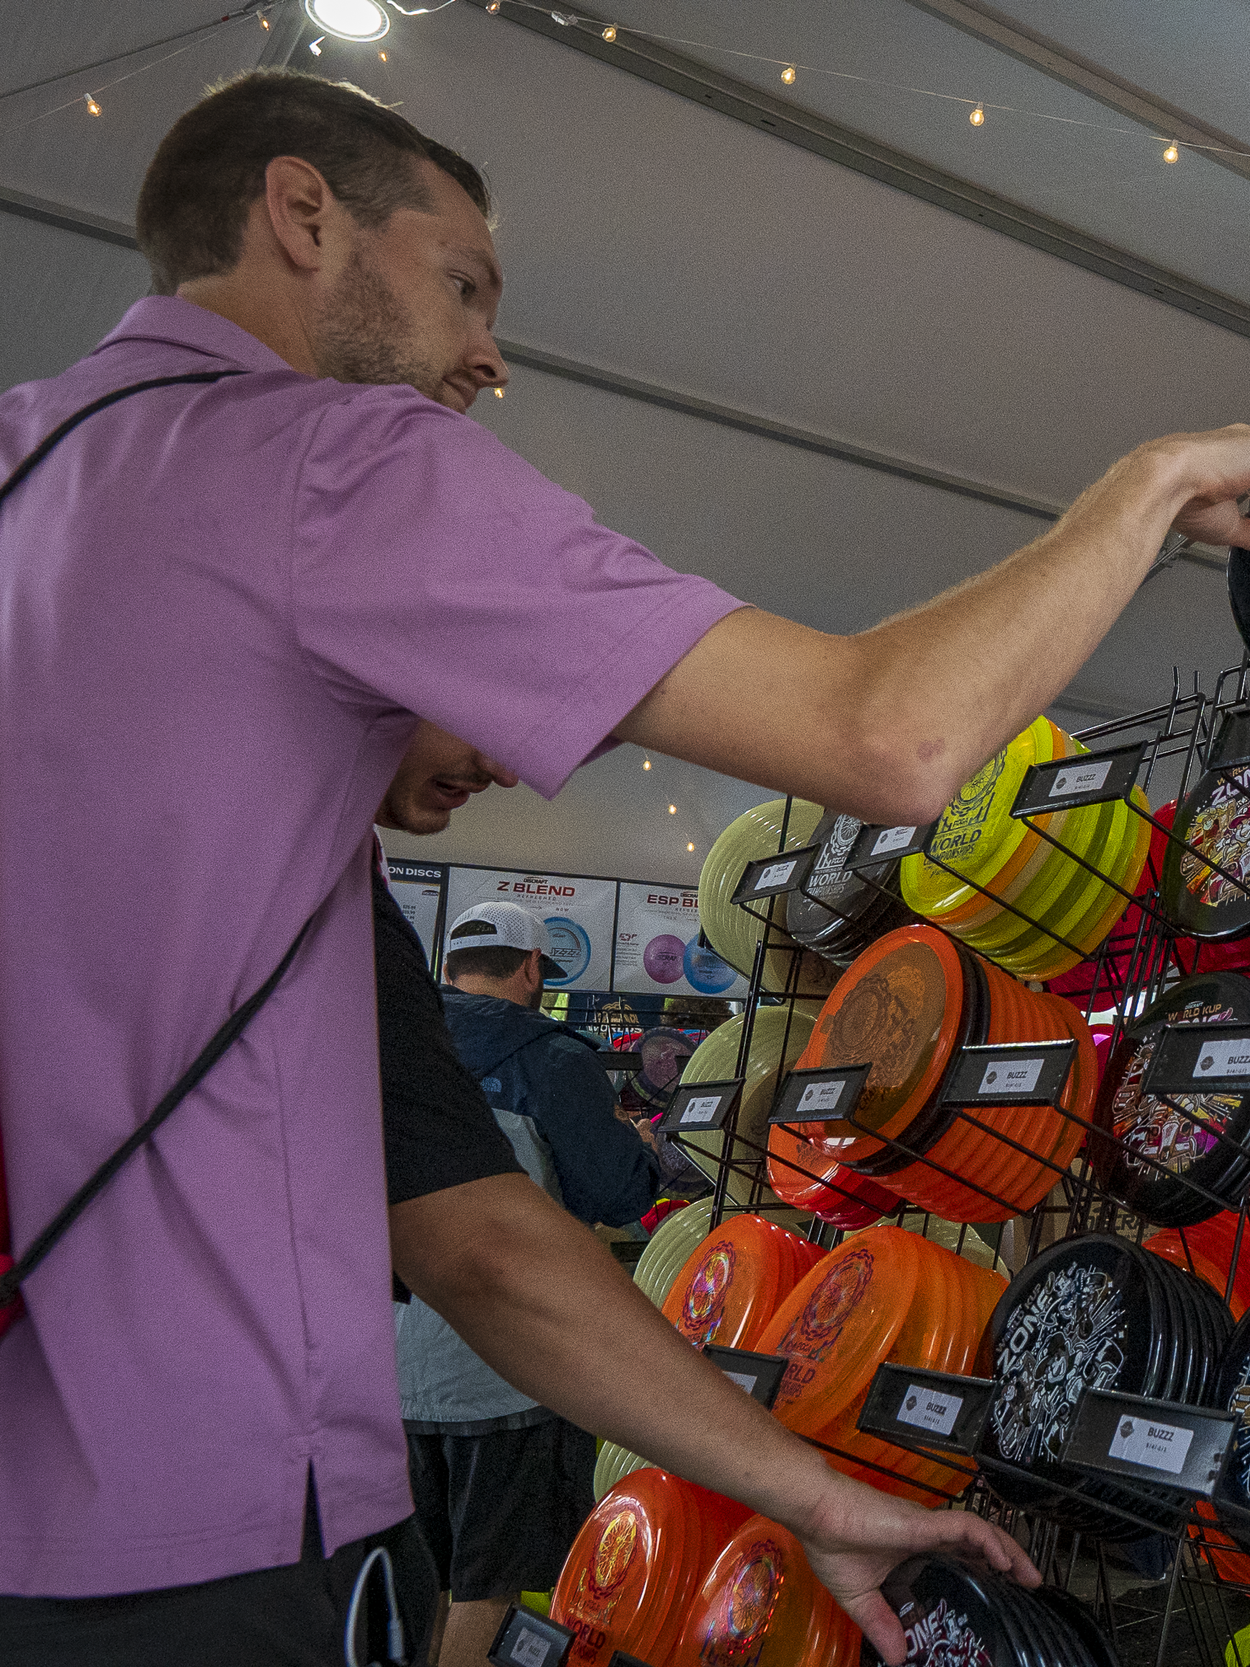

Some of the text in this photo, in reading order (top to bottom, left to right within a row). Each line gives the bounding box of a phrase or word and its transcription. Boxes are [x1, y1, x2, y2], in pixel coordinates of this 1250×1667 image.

[405, 868, 442, 878] DISCS
[808, 871, 853, 888] WORLD
[497, 881, 576, 897] Z BLEND
[647, 894, 679, 906] ESP
[1202, 1004, 1222, 1015] KUP
[1007, 1071, 1028, 1080] BUZZZ
[1147, 1427, 1174, 1442] BUZZZ
